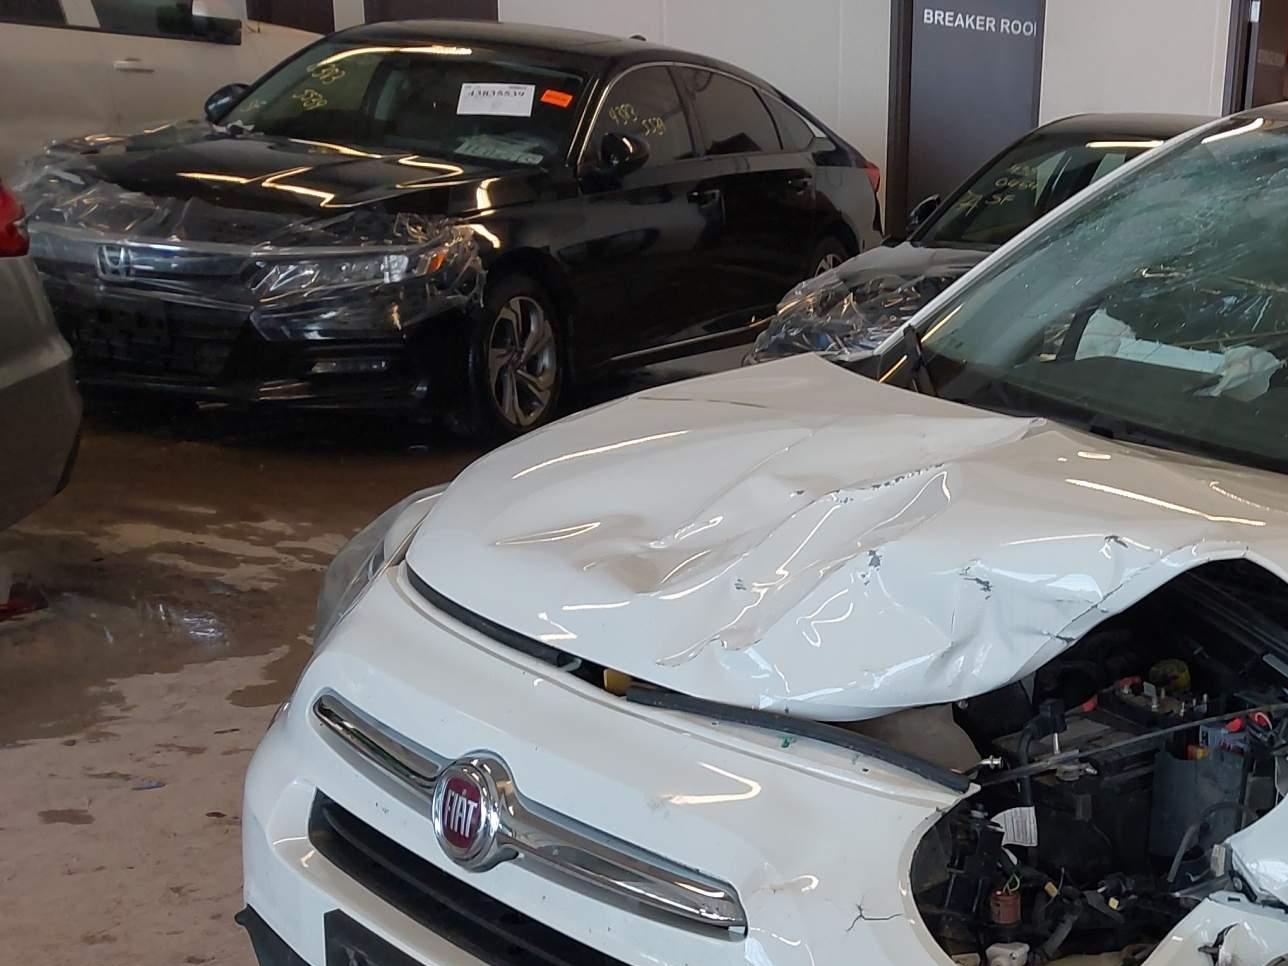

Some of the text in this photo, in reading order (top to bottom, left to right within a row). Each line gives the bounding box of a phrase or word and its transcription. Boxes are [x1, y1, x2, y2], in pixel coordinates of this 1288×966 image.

[923, 8, 1037, 37] BREAKER ROO
[444, 788, 478, 838] FIAT
